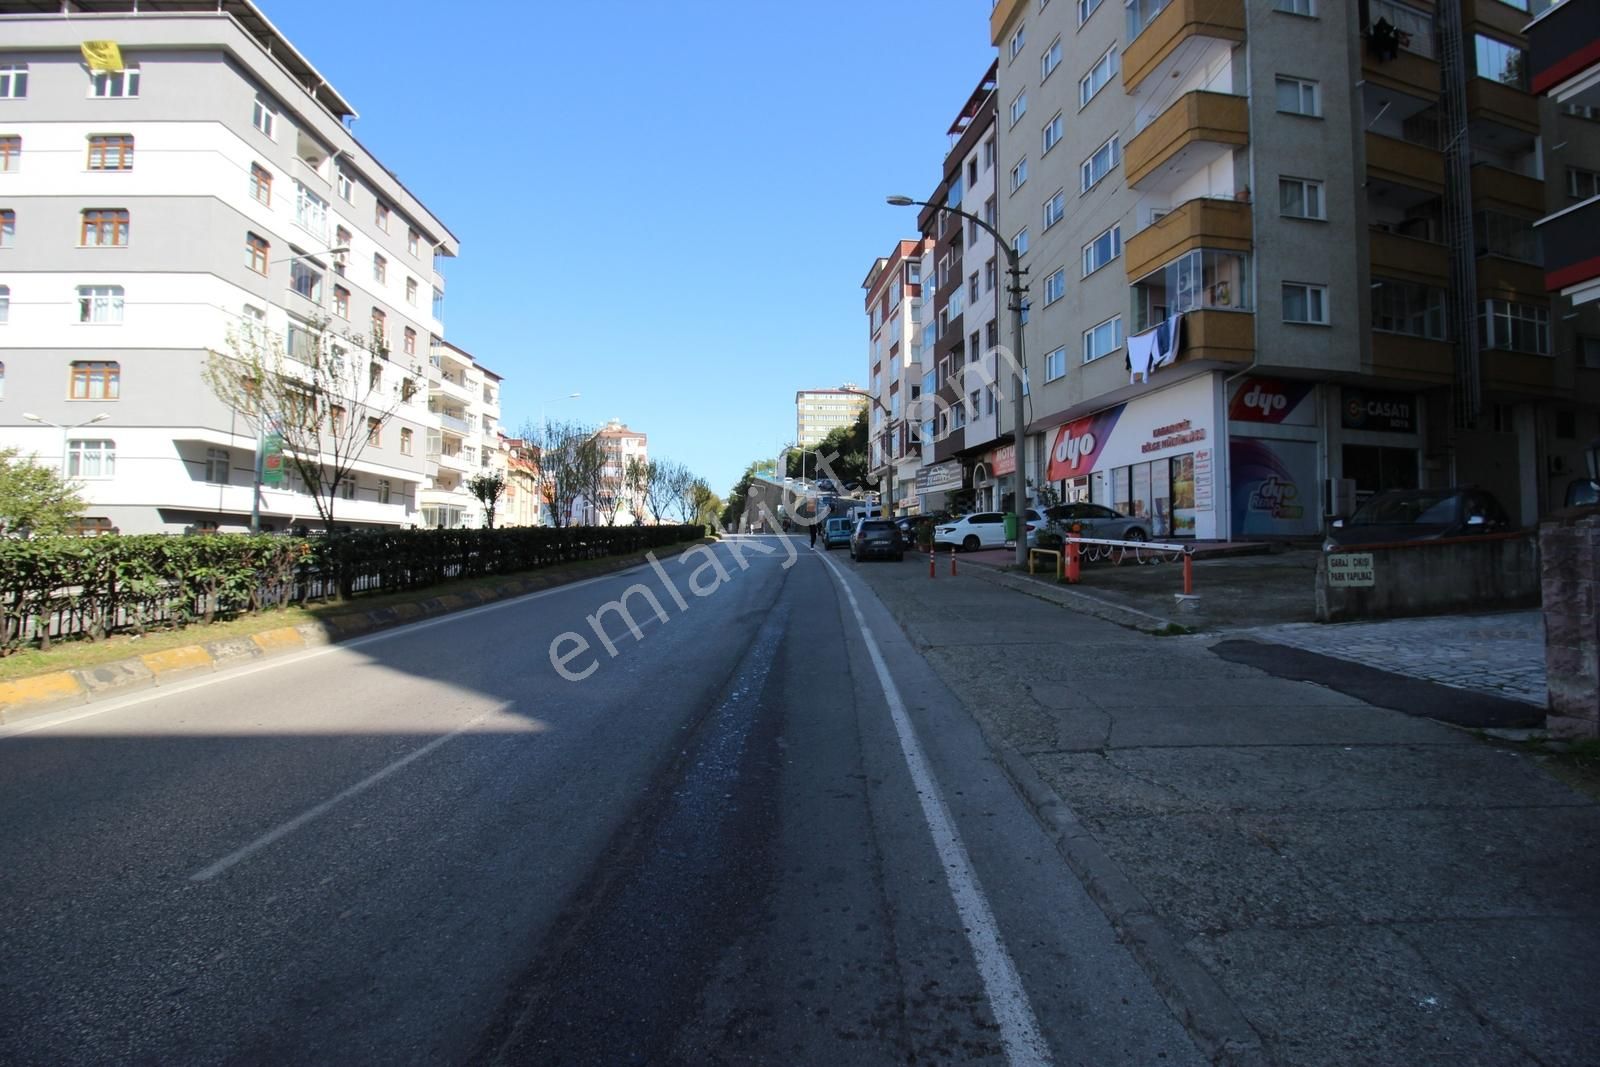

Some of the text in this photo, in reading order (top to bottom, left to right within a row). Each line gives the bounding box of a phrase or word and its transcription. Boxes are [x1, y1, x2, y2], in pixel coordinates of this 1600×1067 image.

[1243, 385, 1287, 415] dyo
[1367, 401, 1409, 418] CASATI
[1056, 430, 1097, 470] dyo
[1260, 477, 1297, 504] dyo
[1331, 558, 1349, 568] GARAJ
[1331, 571, 1373, 581] PARK YAPILMAZ
